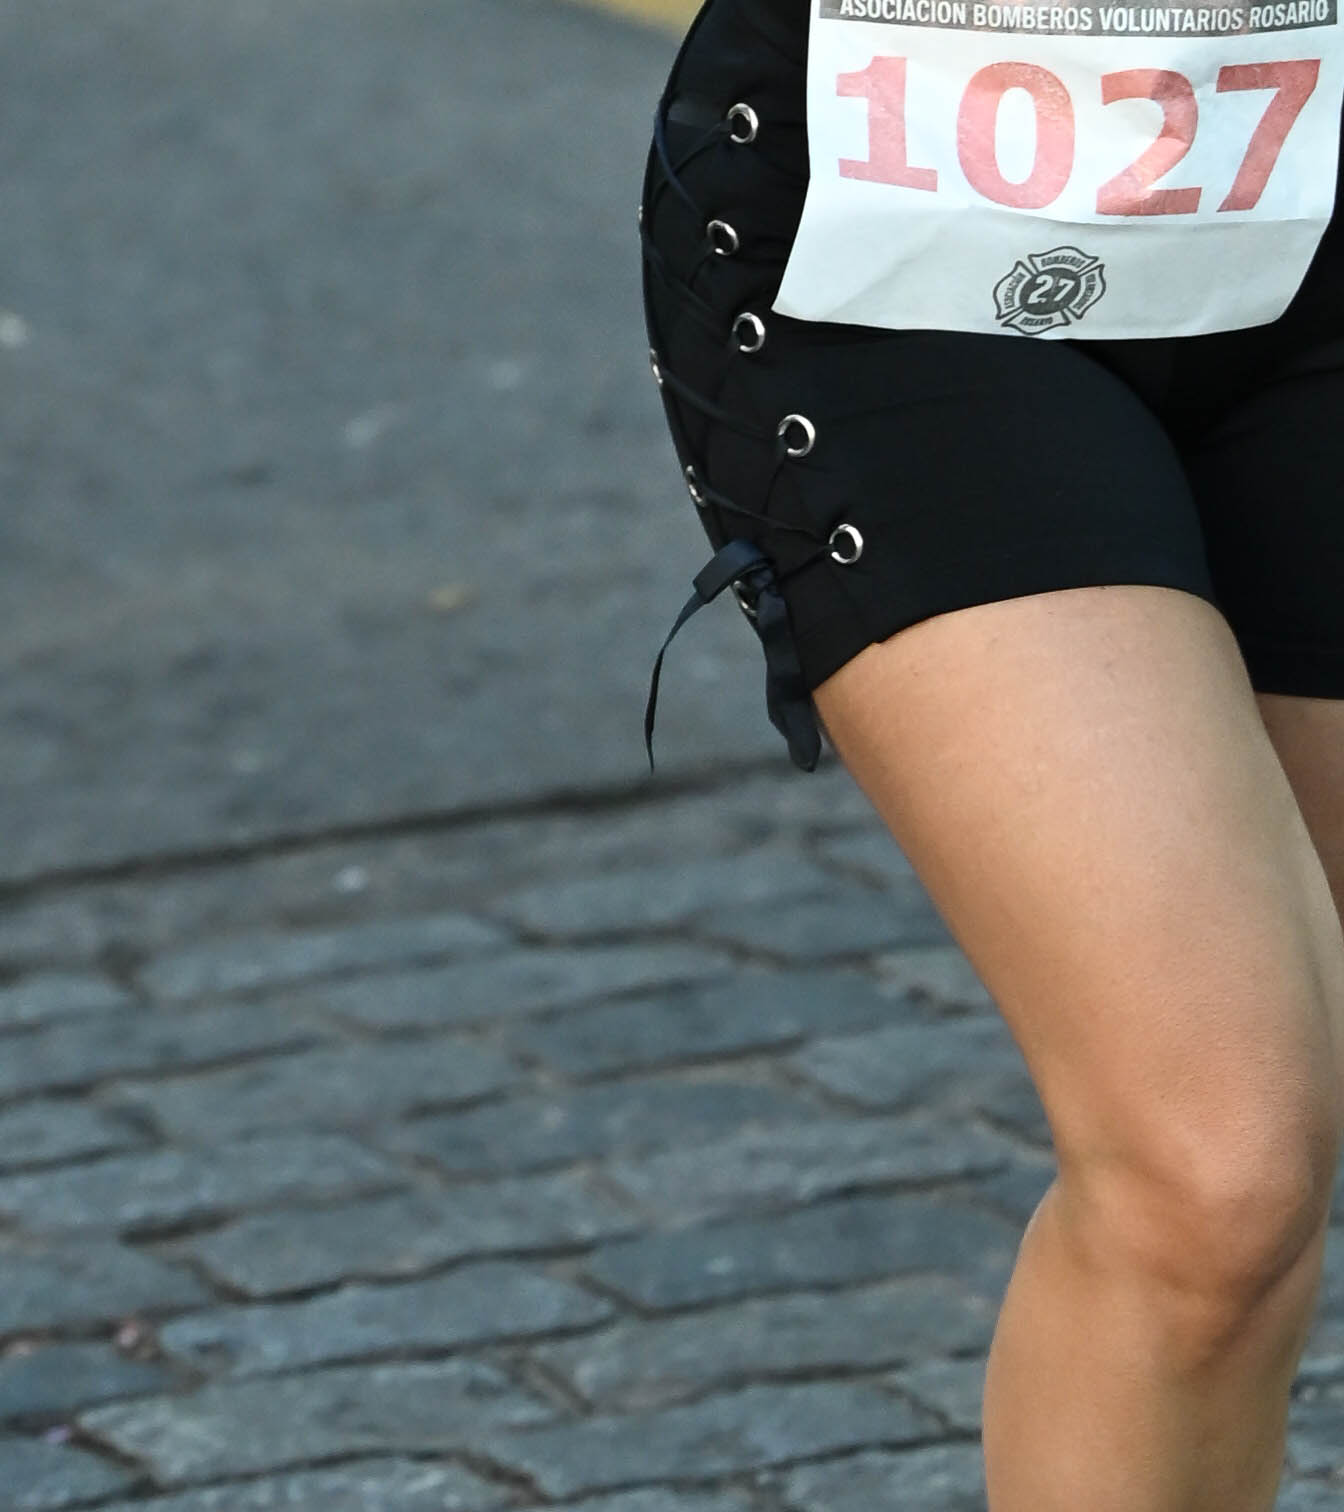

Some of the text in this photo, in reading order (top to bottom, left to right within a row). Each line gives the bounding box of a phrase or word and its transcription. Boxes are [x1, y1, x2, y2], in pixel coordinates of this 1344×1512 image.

[973, 3, 1093, 31] BOMBEROS
[1099, 7, 1244, 32] VOLUNTARIOS
[836, 56, 1322, 216] 1027
[1027, 274, 1077, 304] 27
